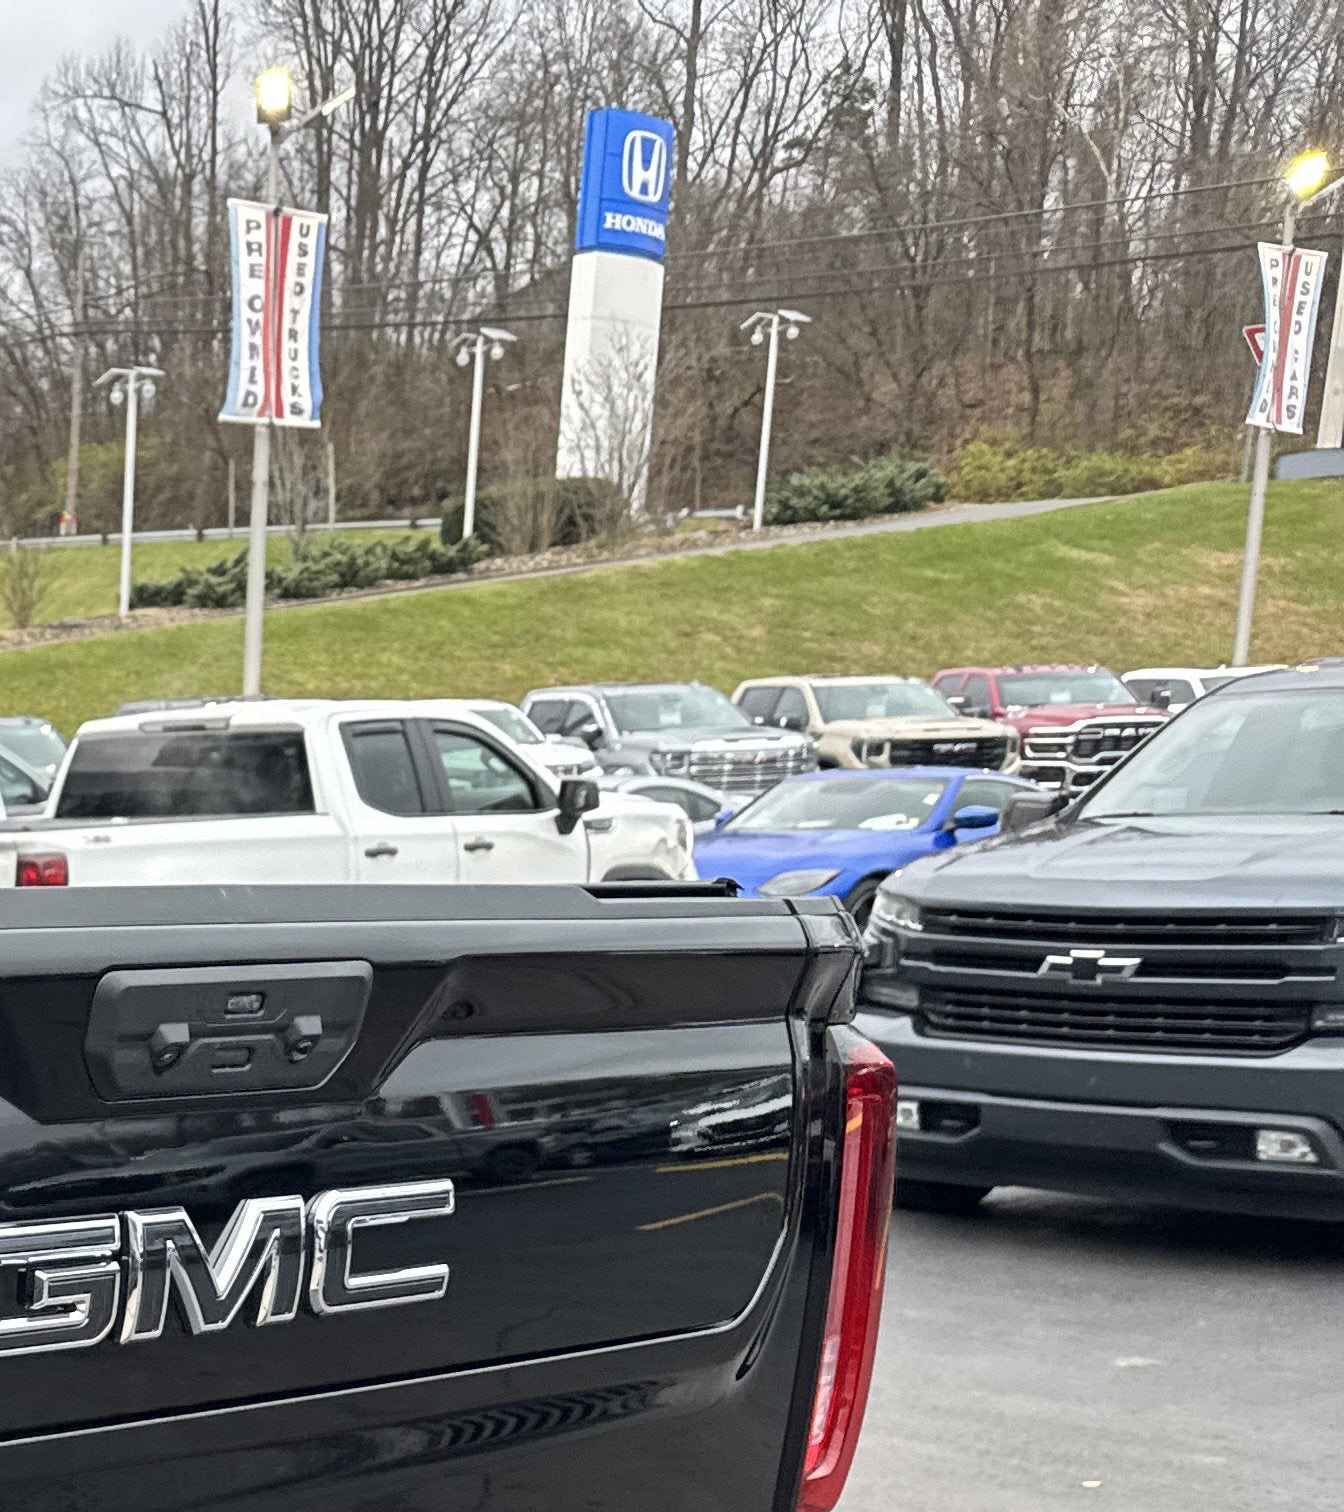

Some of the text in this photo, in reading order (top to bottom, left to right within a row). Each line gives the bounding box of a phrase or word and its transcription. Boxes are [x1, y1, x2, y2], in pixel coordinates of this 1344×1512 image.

[245, 218, 263, 280] PRE
[603, 211, 666, 241] HONDA
[286, 222, 311, 418] USED TRUCKS
[1293, 260, 1314, 336] USED
